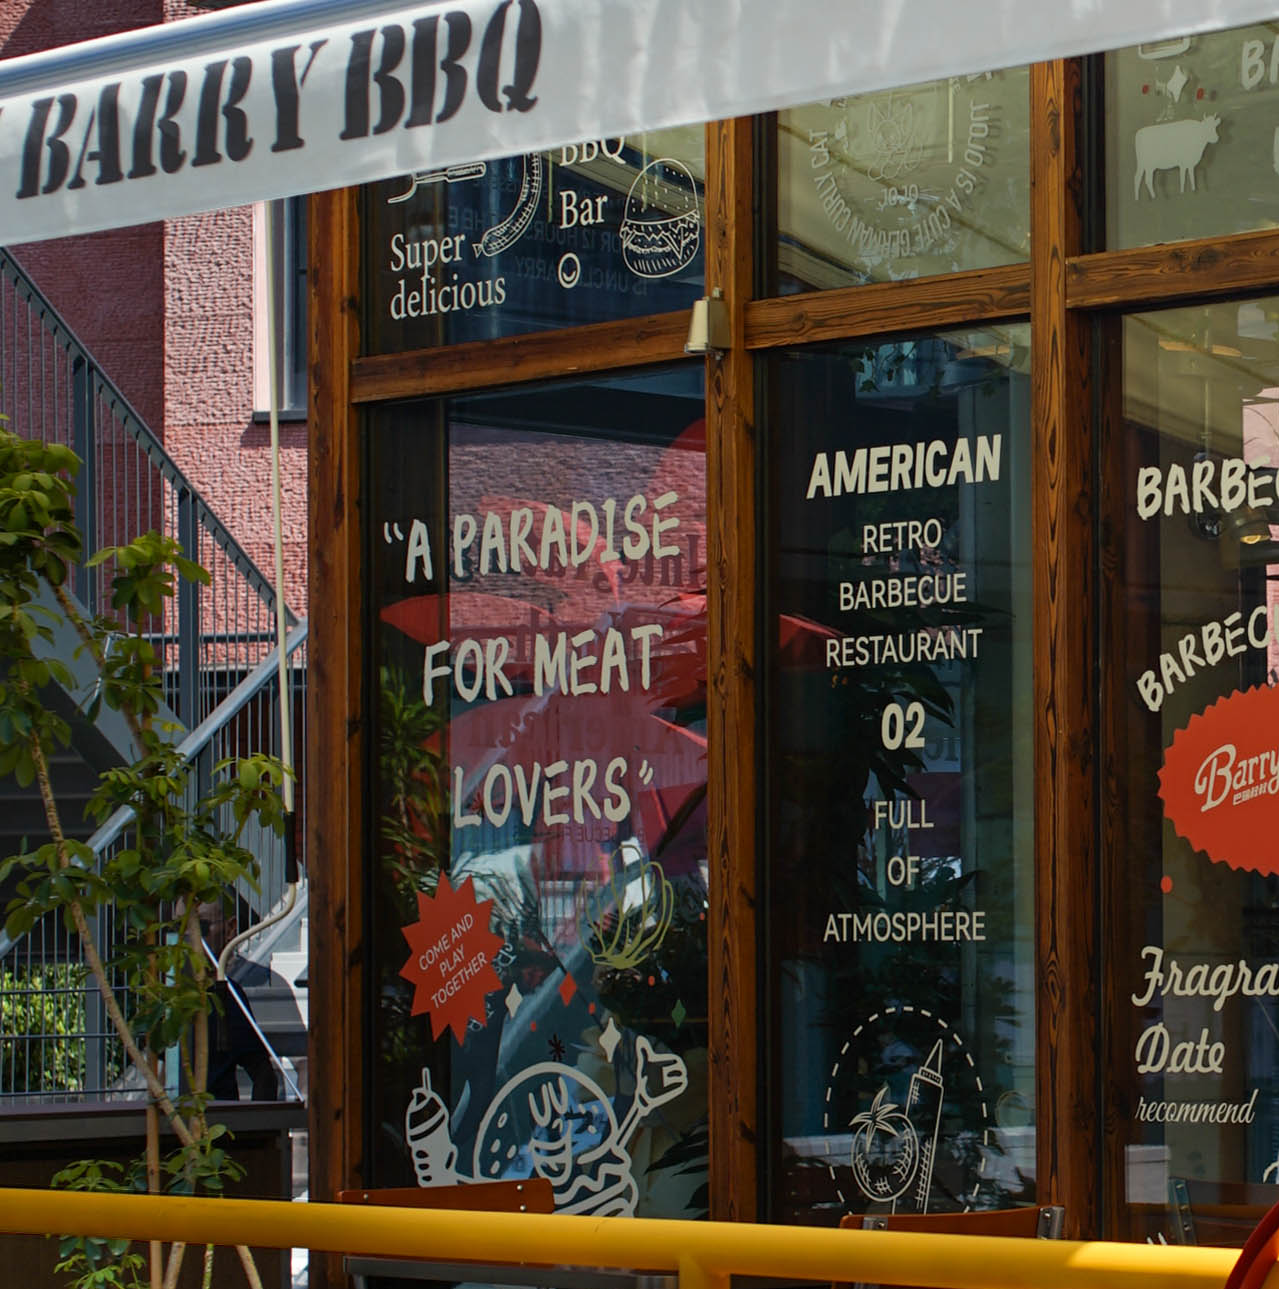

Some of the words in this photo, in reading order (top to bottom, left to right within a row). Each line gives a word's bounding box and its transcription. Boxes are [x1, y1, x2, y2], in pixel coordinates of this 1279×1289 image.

[16, 39, 328, 199] BARRY
[559, 190, 608, 229] Bar
[390, 233, 466, 278] Super
[389, 273, 507, 321] delicious
[807, 434, 1001, 500] AMERICAN
[453, 491, 680, 578] PARADISE
[863, 518, 942, 554] RETRO
[839, 573, 967, 611] BARBECUE
[423, 637, 513, 706] FOR
[534, 624, 663, 697] MEAT
[826, 629, 983, 667] RESTAURANT
[881, 702, 926, 751] 02
[874, 800, 934, 830] FULL
[887, 856, 920, 886] OF
[418, 935, 451, 972] COME
[451, 913, 475, 941] AND
[823, 912, 986, 943] ATMOSPHERE
[431, 951, 489, 1010] TOGETHER
[439, 943, 467, 979] PLAY
[1135, 1022, 1225, 1075] Date
[1134, 1089, 1259, 1124] recommend
